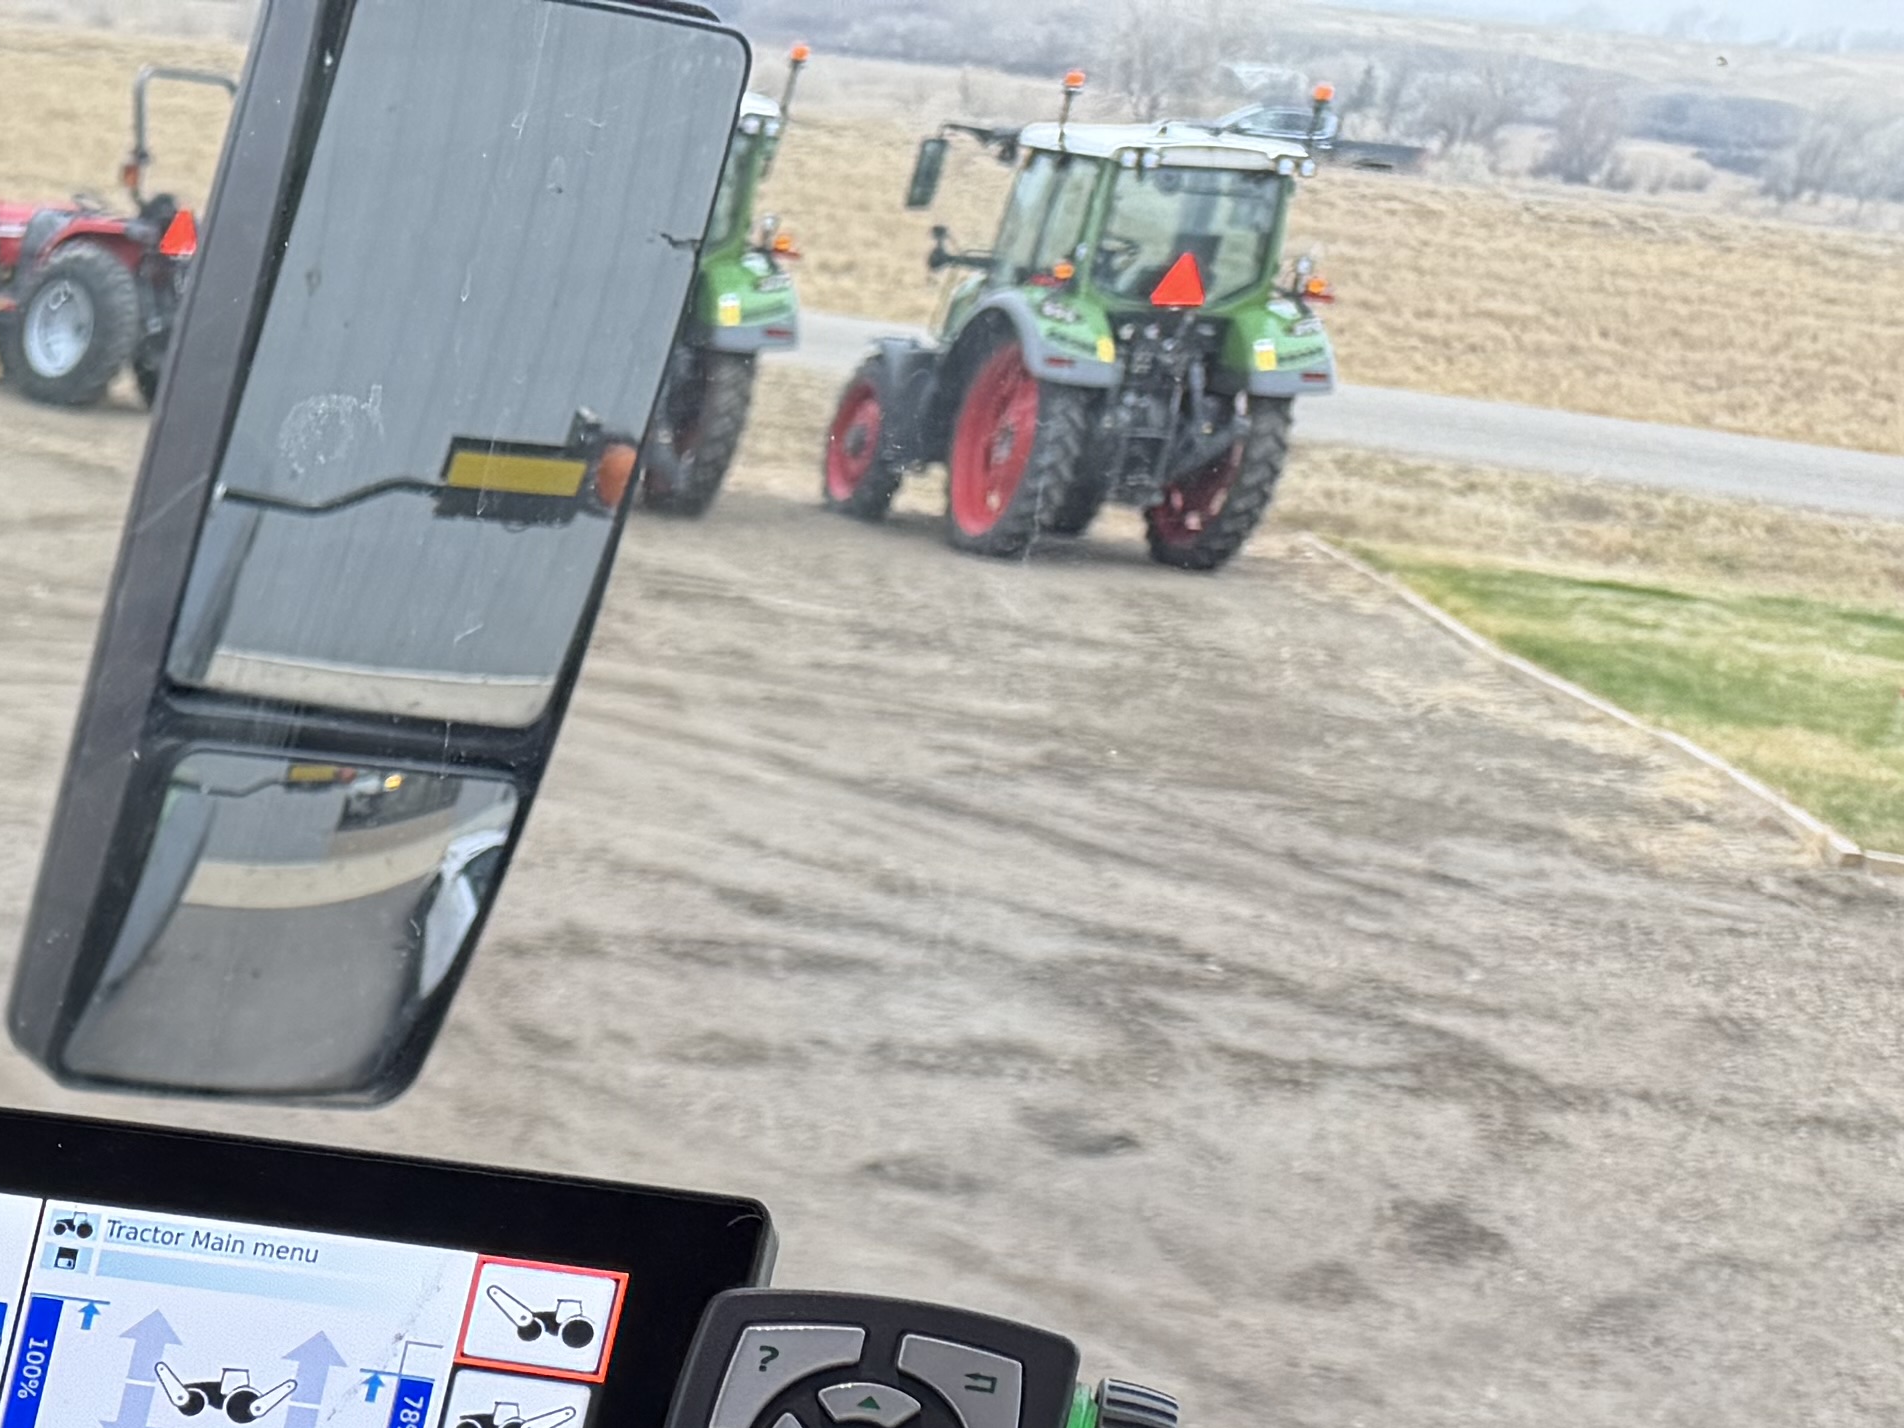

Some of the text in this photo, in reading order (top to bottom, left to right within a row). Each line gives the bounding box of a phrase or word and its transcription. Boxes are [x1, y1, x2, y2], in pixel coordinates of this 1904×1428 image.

[107, 1219, 319, 1263] Tractor Main menu
[17, 1338, 48, 1399] 100%
